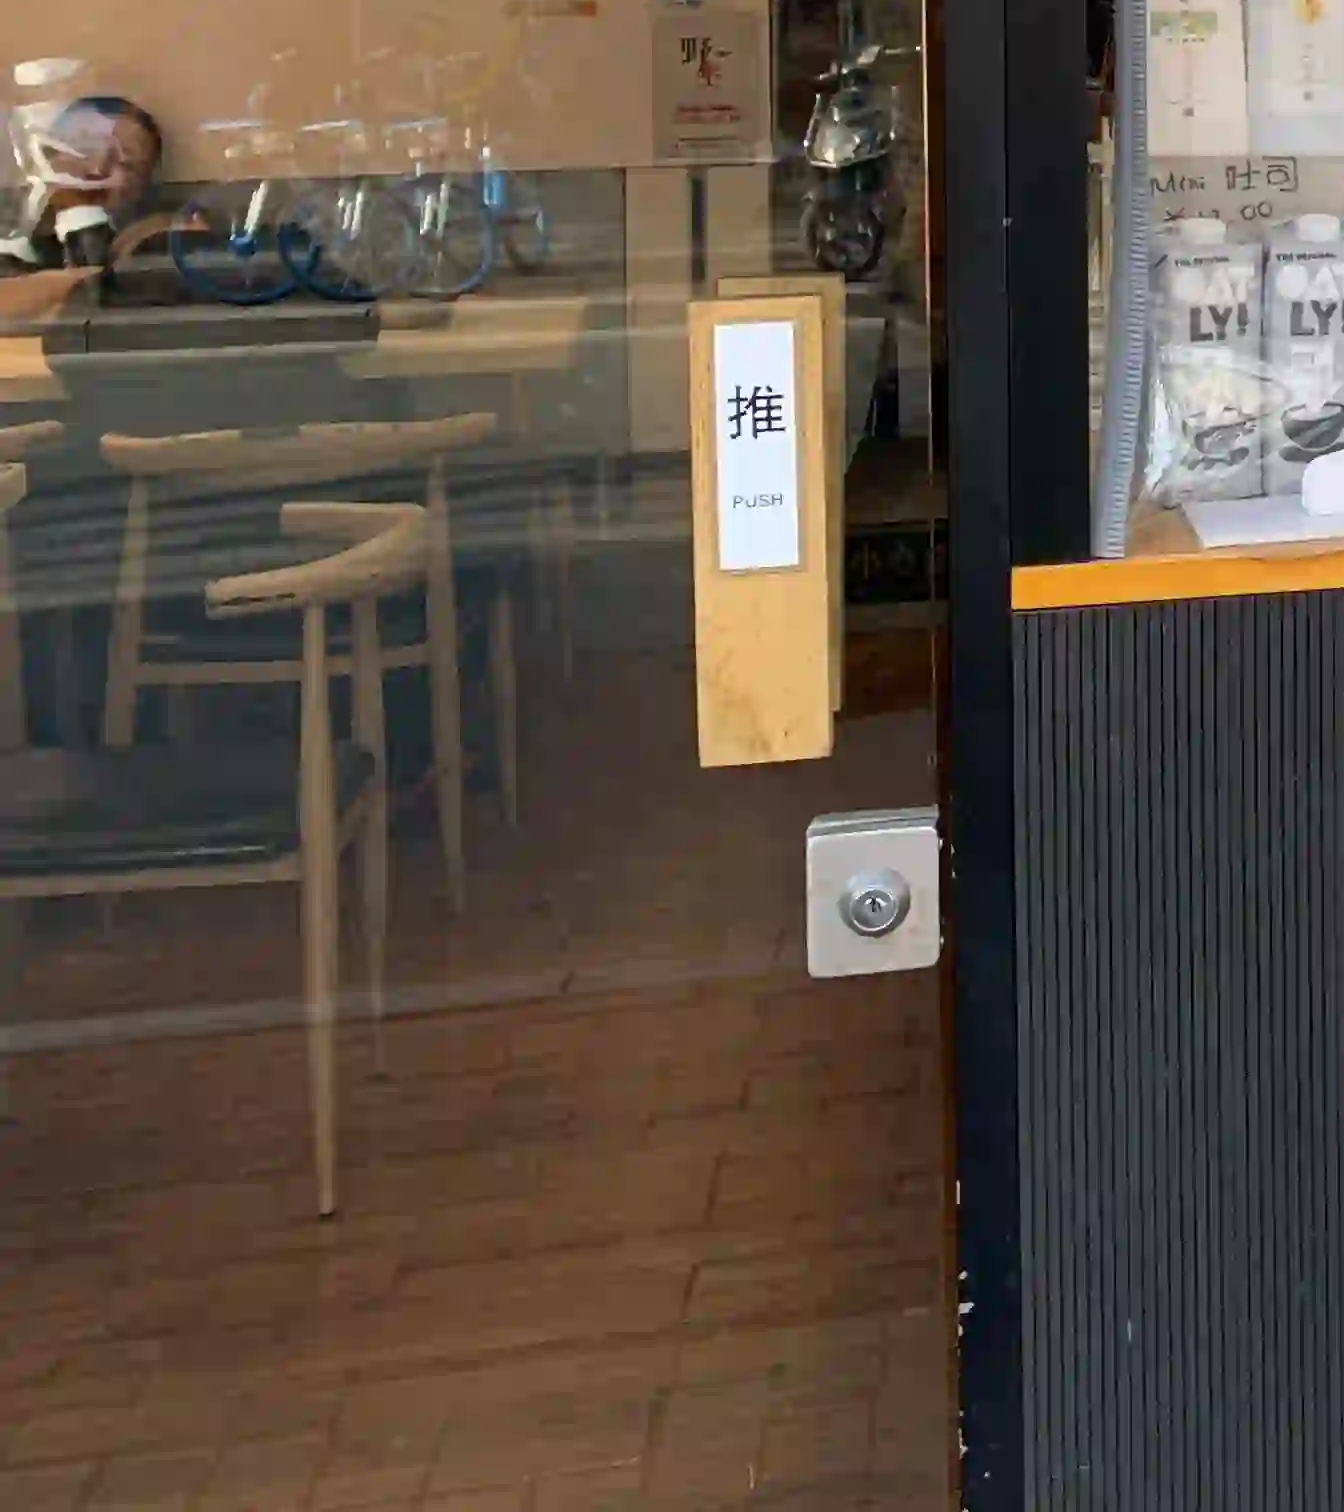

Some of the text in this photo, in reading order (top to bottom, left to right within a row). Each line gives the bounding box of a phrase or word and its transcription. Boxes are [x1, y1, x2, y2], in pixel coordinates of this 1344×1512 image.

[1226, 155, 1298, 192] 吐司
[727, 385, 786, 439] 推
[732, 492, 784, 509] PUSH
